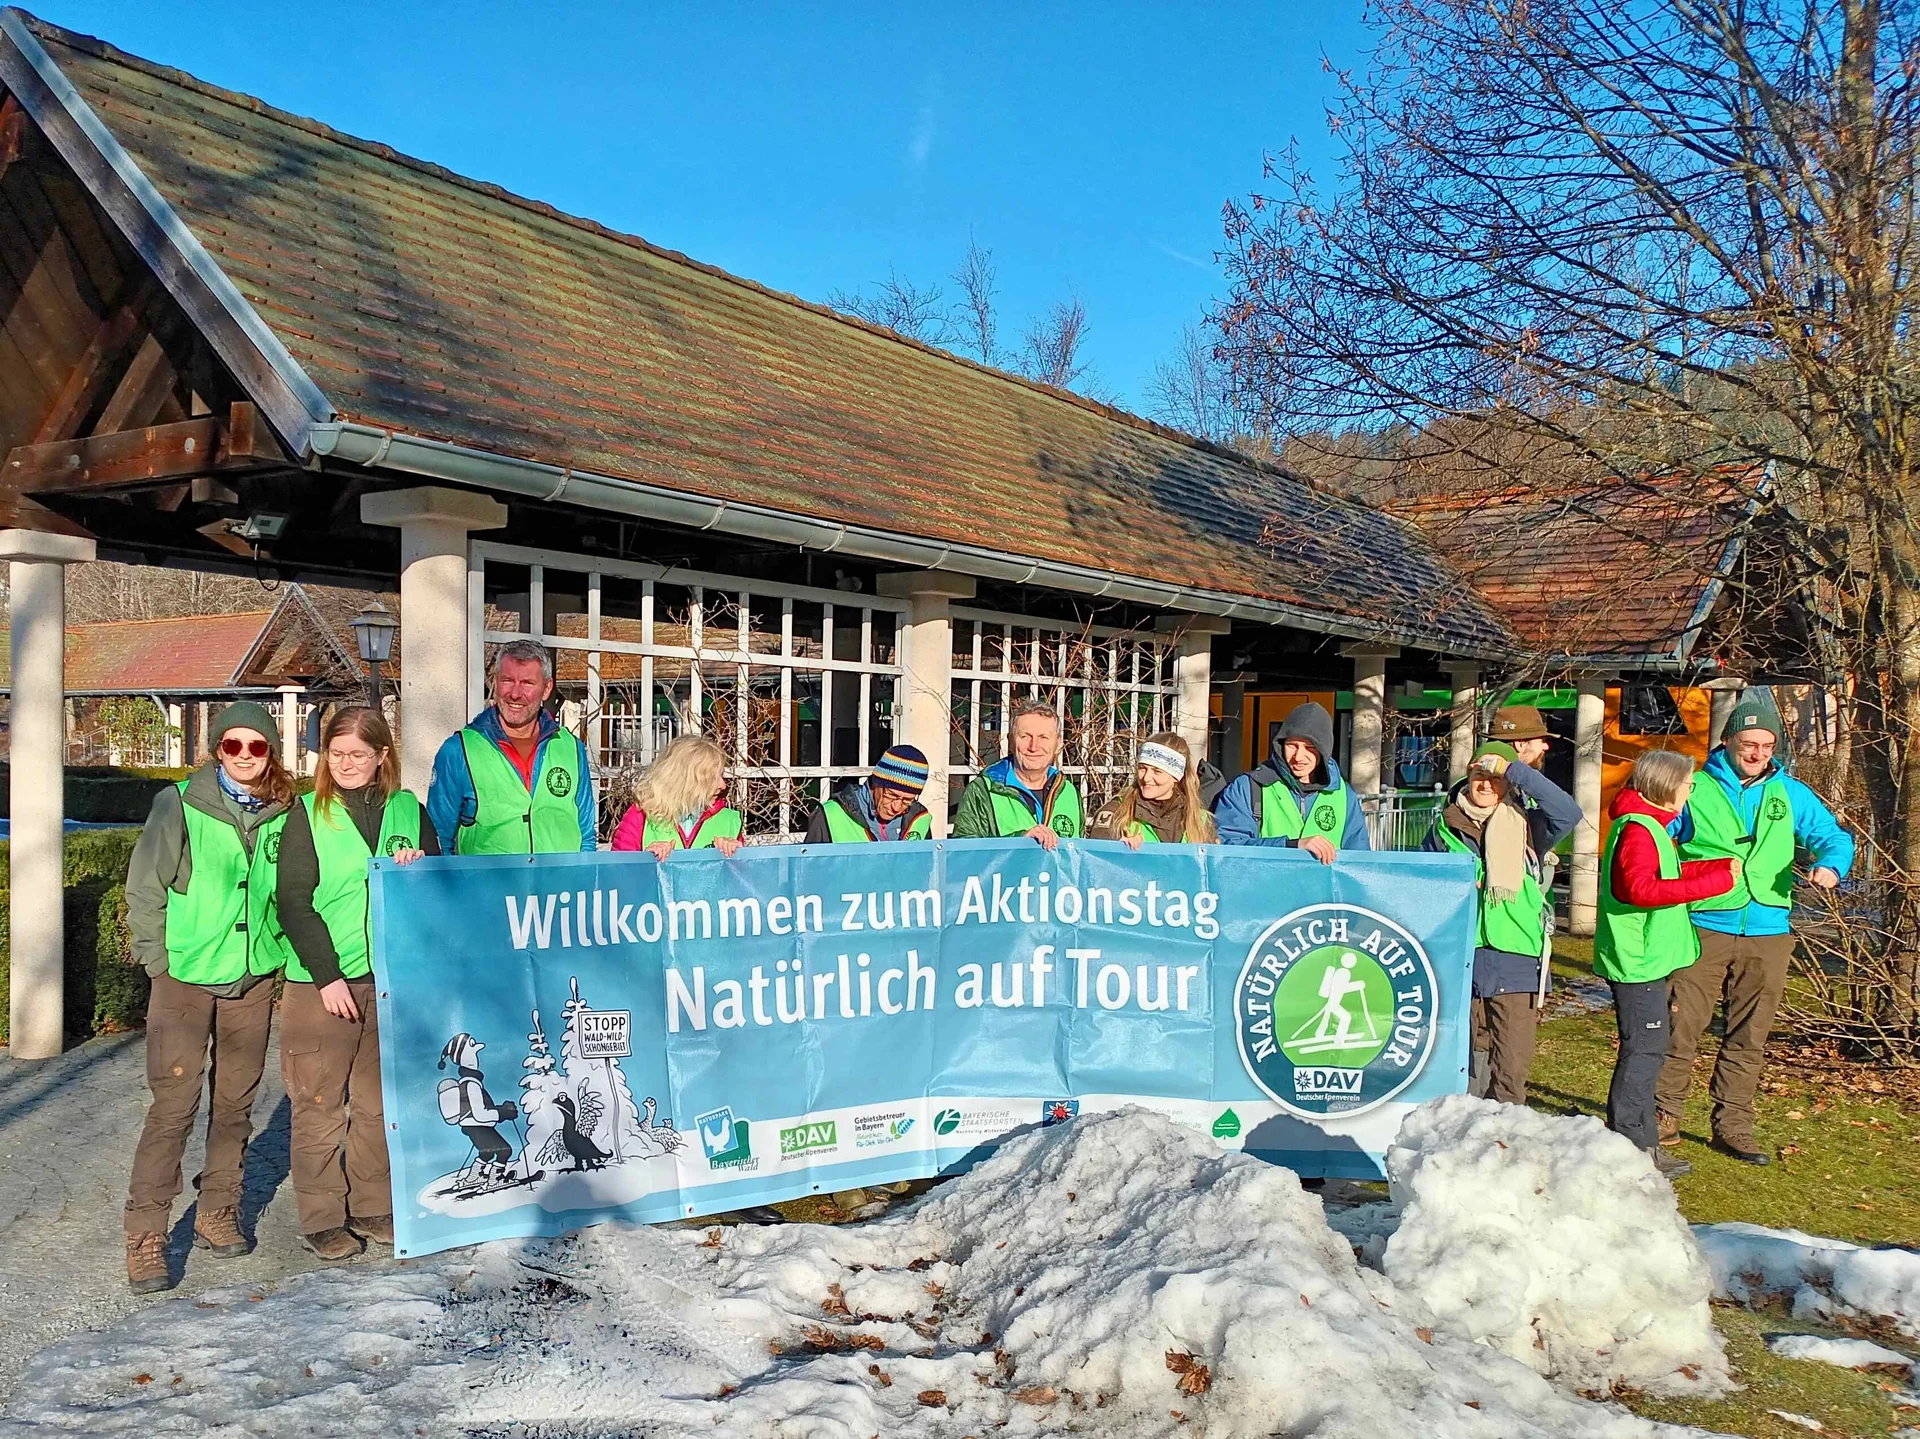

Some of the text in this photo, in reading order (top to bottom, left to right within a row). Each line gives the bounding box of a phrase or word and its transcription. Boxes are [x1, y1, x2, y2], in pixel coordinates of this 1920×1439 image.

[505, 872, 1220, 951] Willkommen zum Aktionstag
[664, 945, 1199, 1034] Natürlich auf Tour
[1246, 918, 1424, 1067] NATÜRLICH AUF TOUR
[584, 1017, 626, 1031] STOPP
[584, 1032, 625, 1042] WALD-WILD-
[585, 1042, 626, 1052] SCHONGEBIET
[1313, 1070, 1361, 1090] DAV
[1296, 1093, 1324, 1101] Deutscher
[699, 1110, 729, 1124] NATURPARK
[854, 1112, 905, 1124] Gebietsbetreuer
[962, 1110, 1011, 1120] BAYERISCHE
[862, 1122, 885, 1131] Bayern
[960, 1117, 1025, 1128] STAATSFORSTEN
[796, 1123, 834, 1147] DAV
